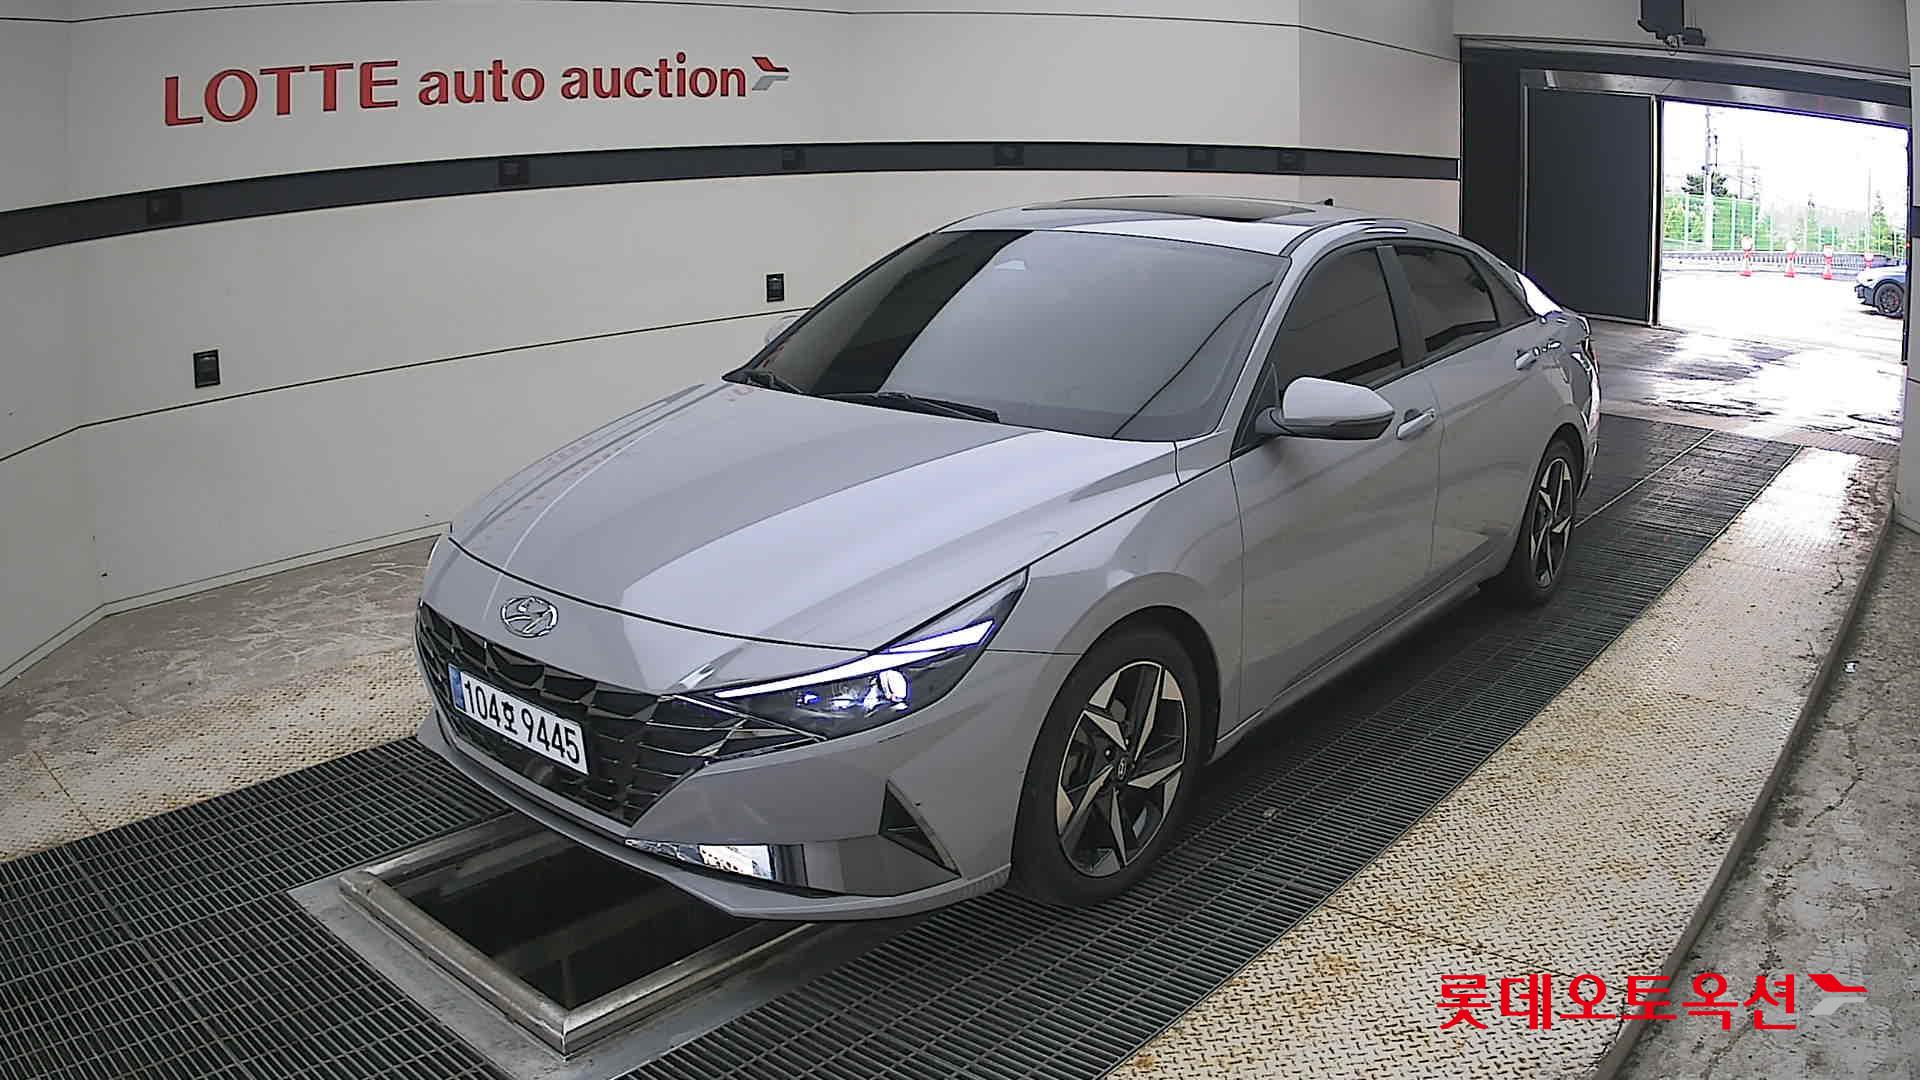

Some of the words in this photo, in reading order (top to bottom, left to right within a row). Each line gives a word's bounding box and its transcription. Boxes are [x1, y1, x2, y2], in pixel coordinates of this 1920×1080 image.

[164, 60, 399, 126] LOTTE
[418, 58, 546, 105] auto
[560, 51, 747, 99] auction
[464, 680, 518, 735] 104호
[521, 708, 580, 764] 9445
